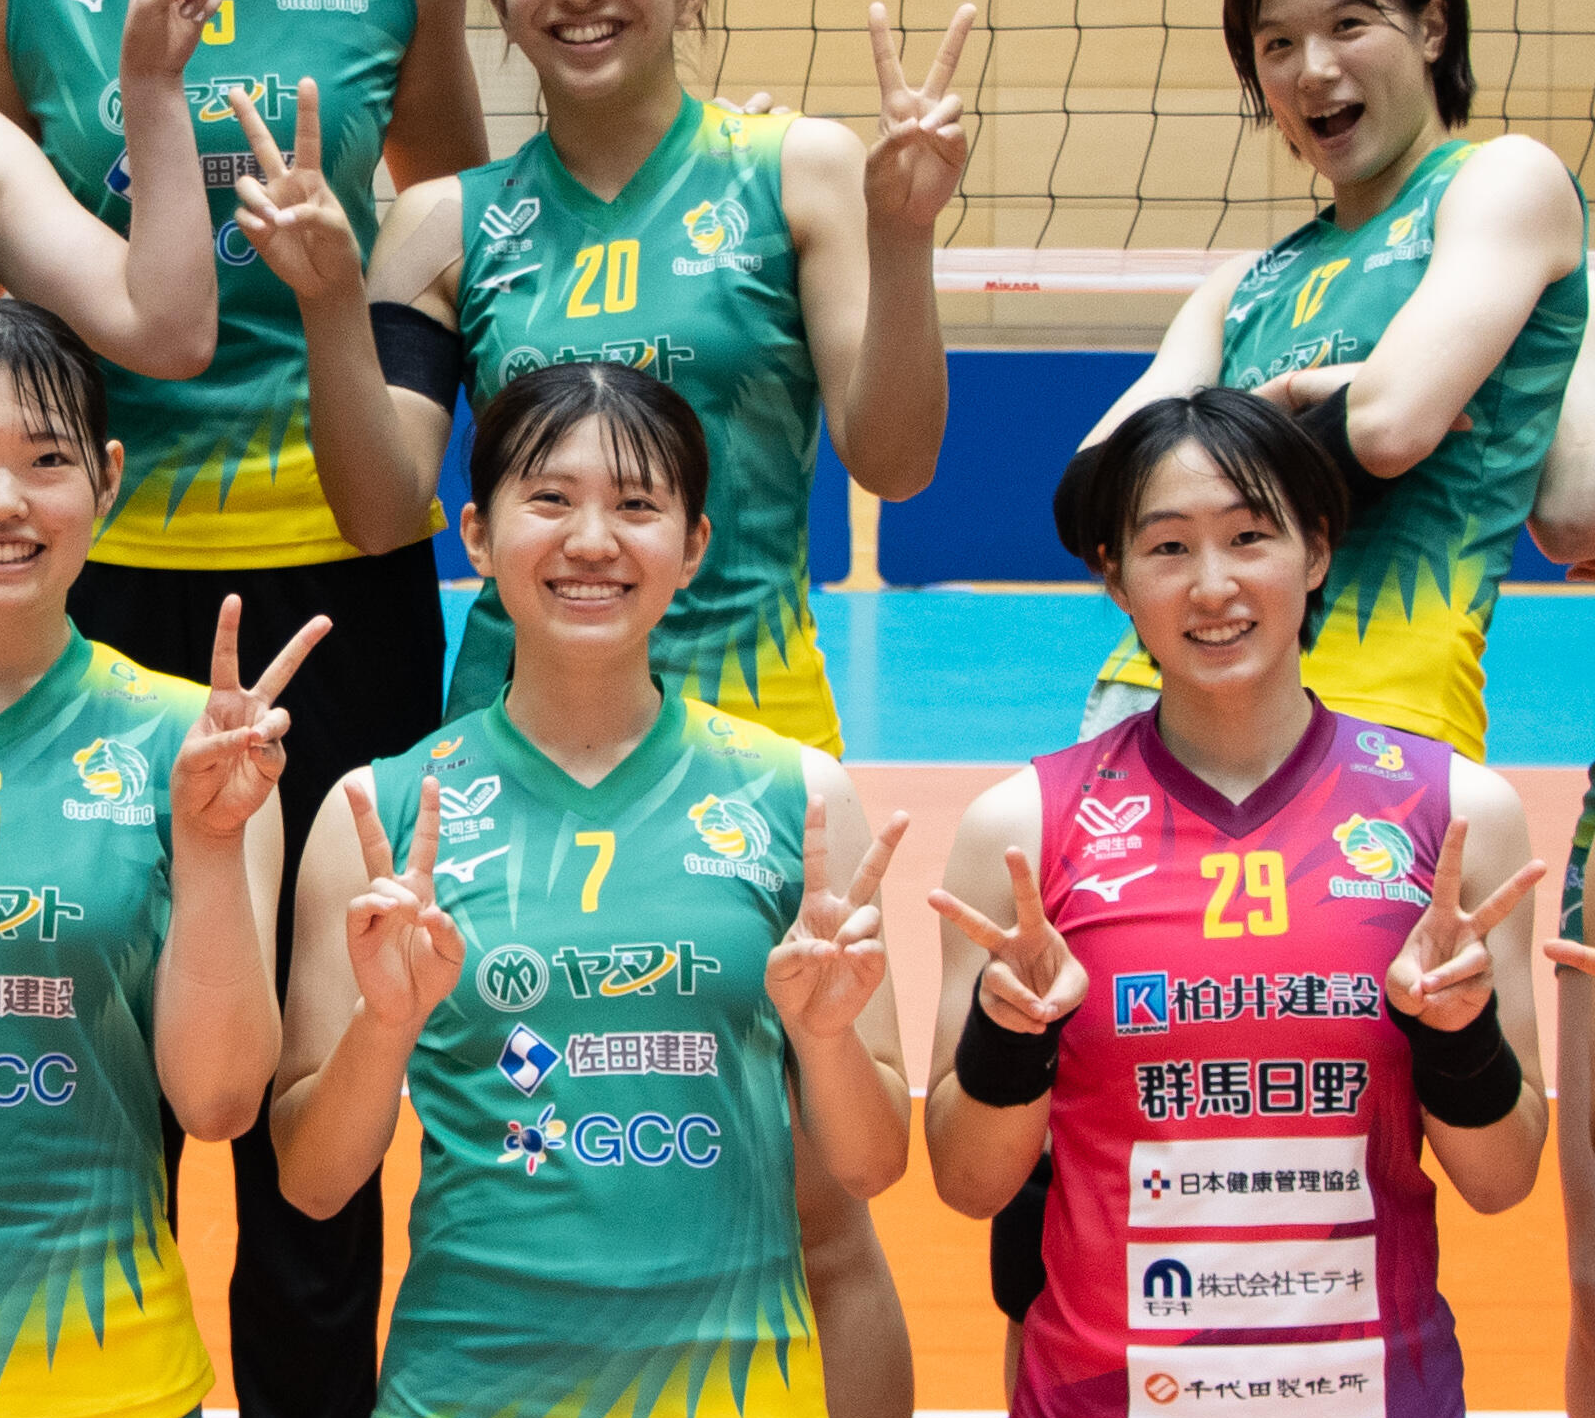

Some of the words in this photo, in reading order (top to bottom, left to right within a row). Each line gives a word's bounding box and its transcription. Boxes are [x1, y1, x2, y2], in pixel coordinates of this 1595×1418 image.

[566, 240, 640, 318] 20
[575, 831, 616, 913] 7
[1200, 850, 1289, 939] 29
[554, 940, 721, 999] ヤマト
[1171, 973, 1381, 1022] 柏井建設
[566, 1032, 719, 1078] 佐田建設
[1136, 1059, 1370, 1120] 群馬日野
[572, 1111, 721, 1168] GCC
[1179, 1168, 1362, 1195] 日本健康管理協会
[1197, 1269, 1365, 1298] 株式会社モテキ
